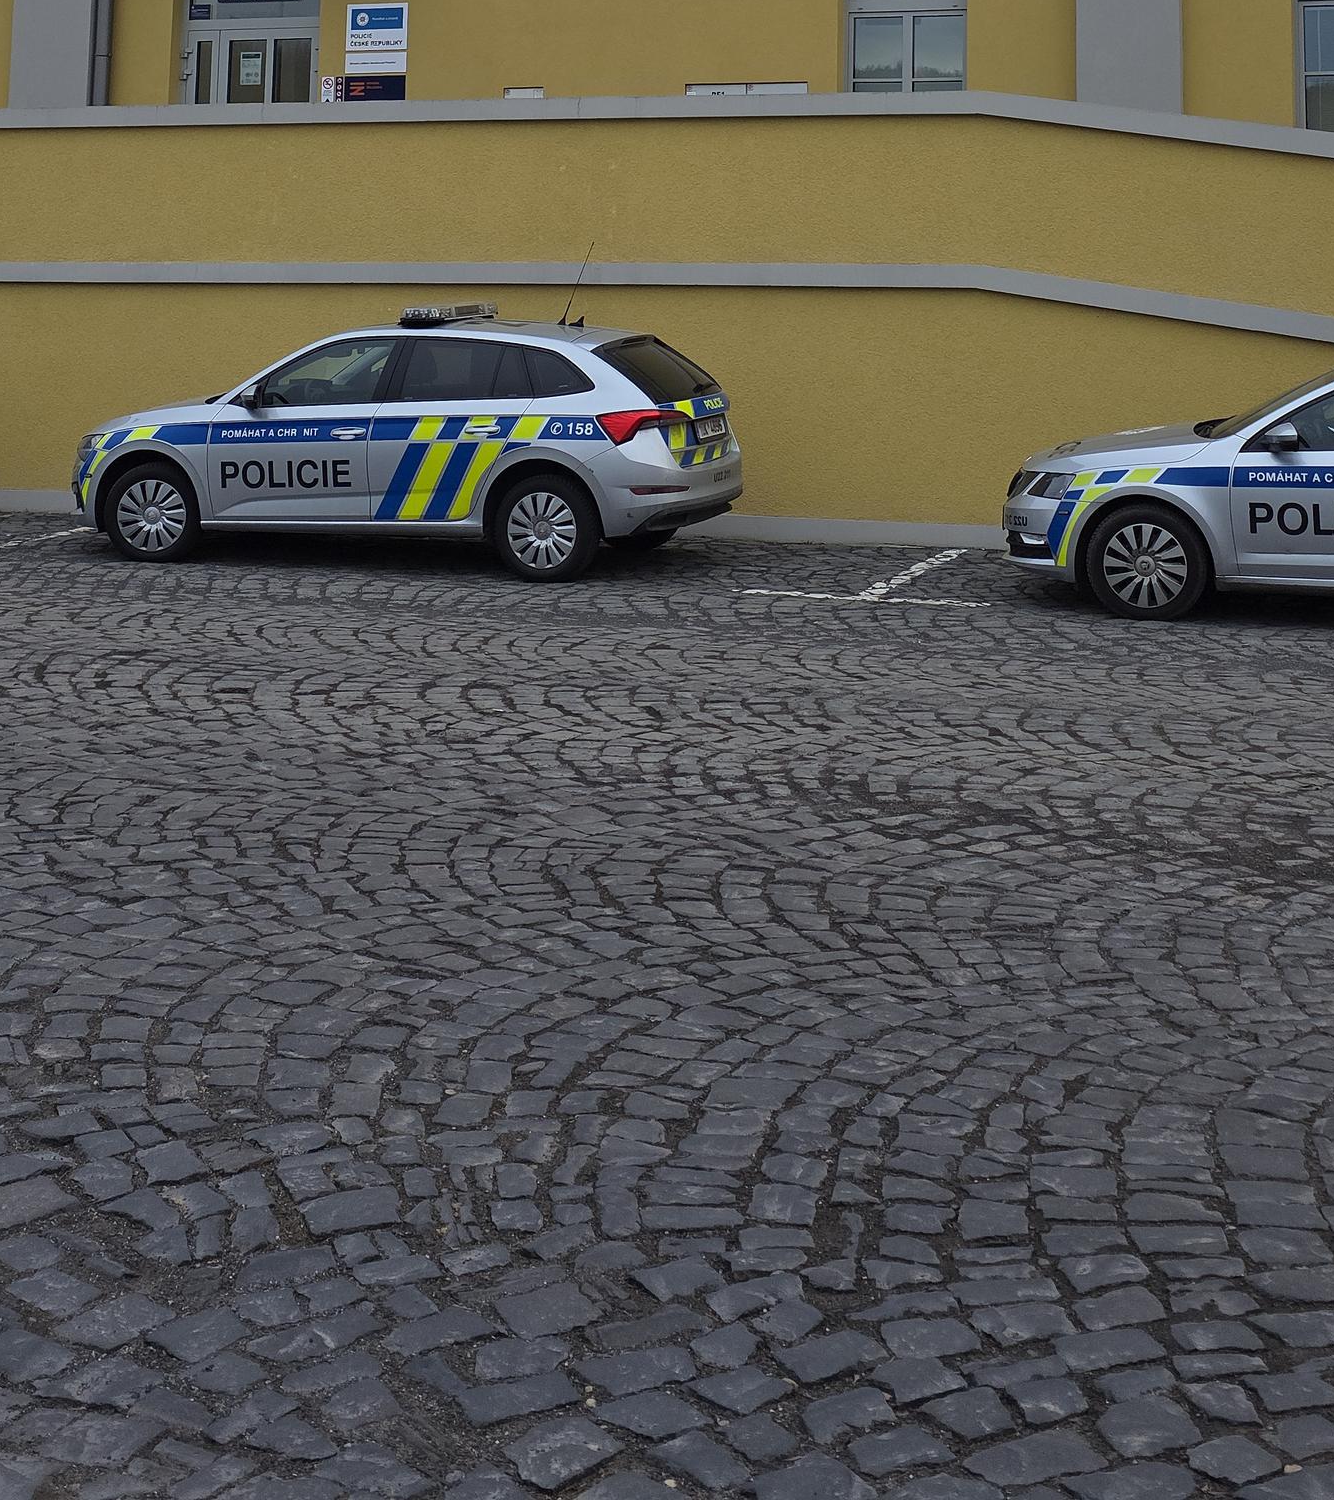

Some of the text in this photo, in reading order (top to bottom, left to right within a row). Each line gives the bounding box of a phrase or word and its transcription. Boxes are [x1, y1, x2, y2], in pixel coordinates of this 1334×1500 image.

[221, 428, 266, 438] POMÁHAT
[567, 422, 594, 436] 158
[220, 459, 352, 489] POLICIE
[1249, 471, 1308, 483] POMÁHAT
[1312, 473, 1321, 483] A
